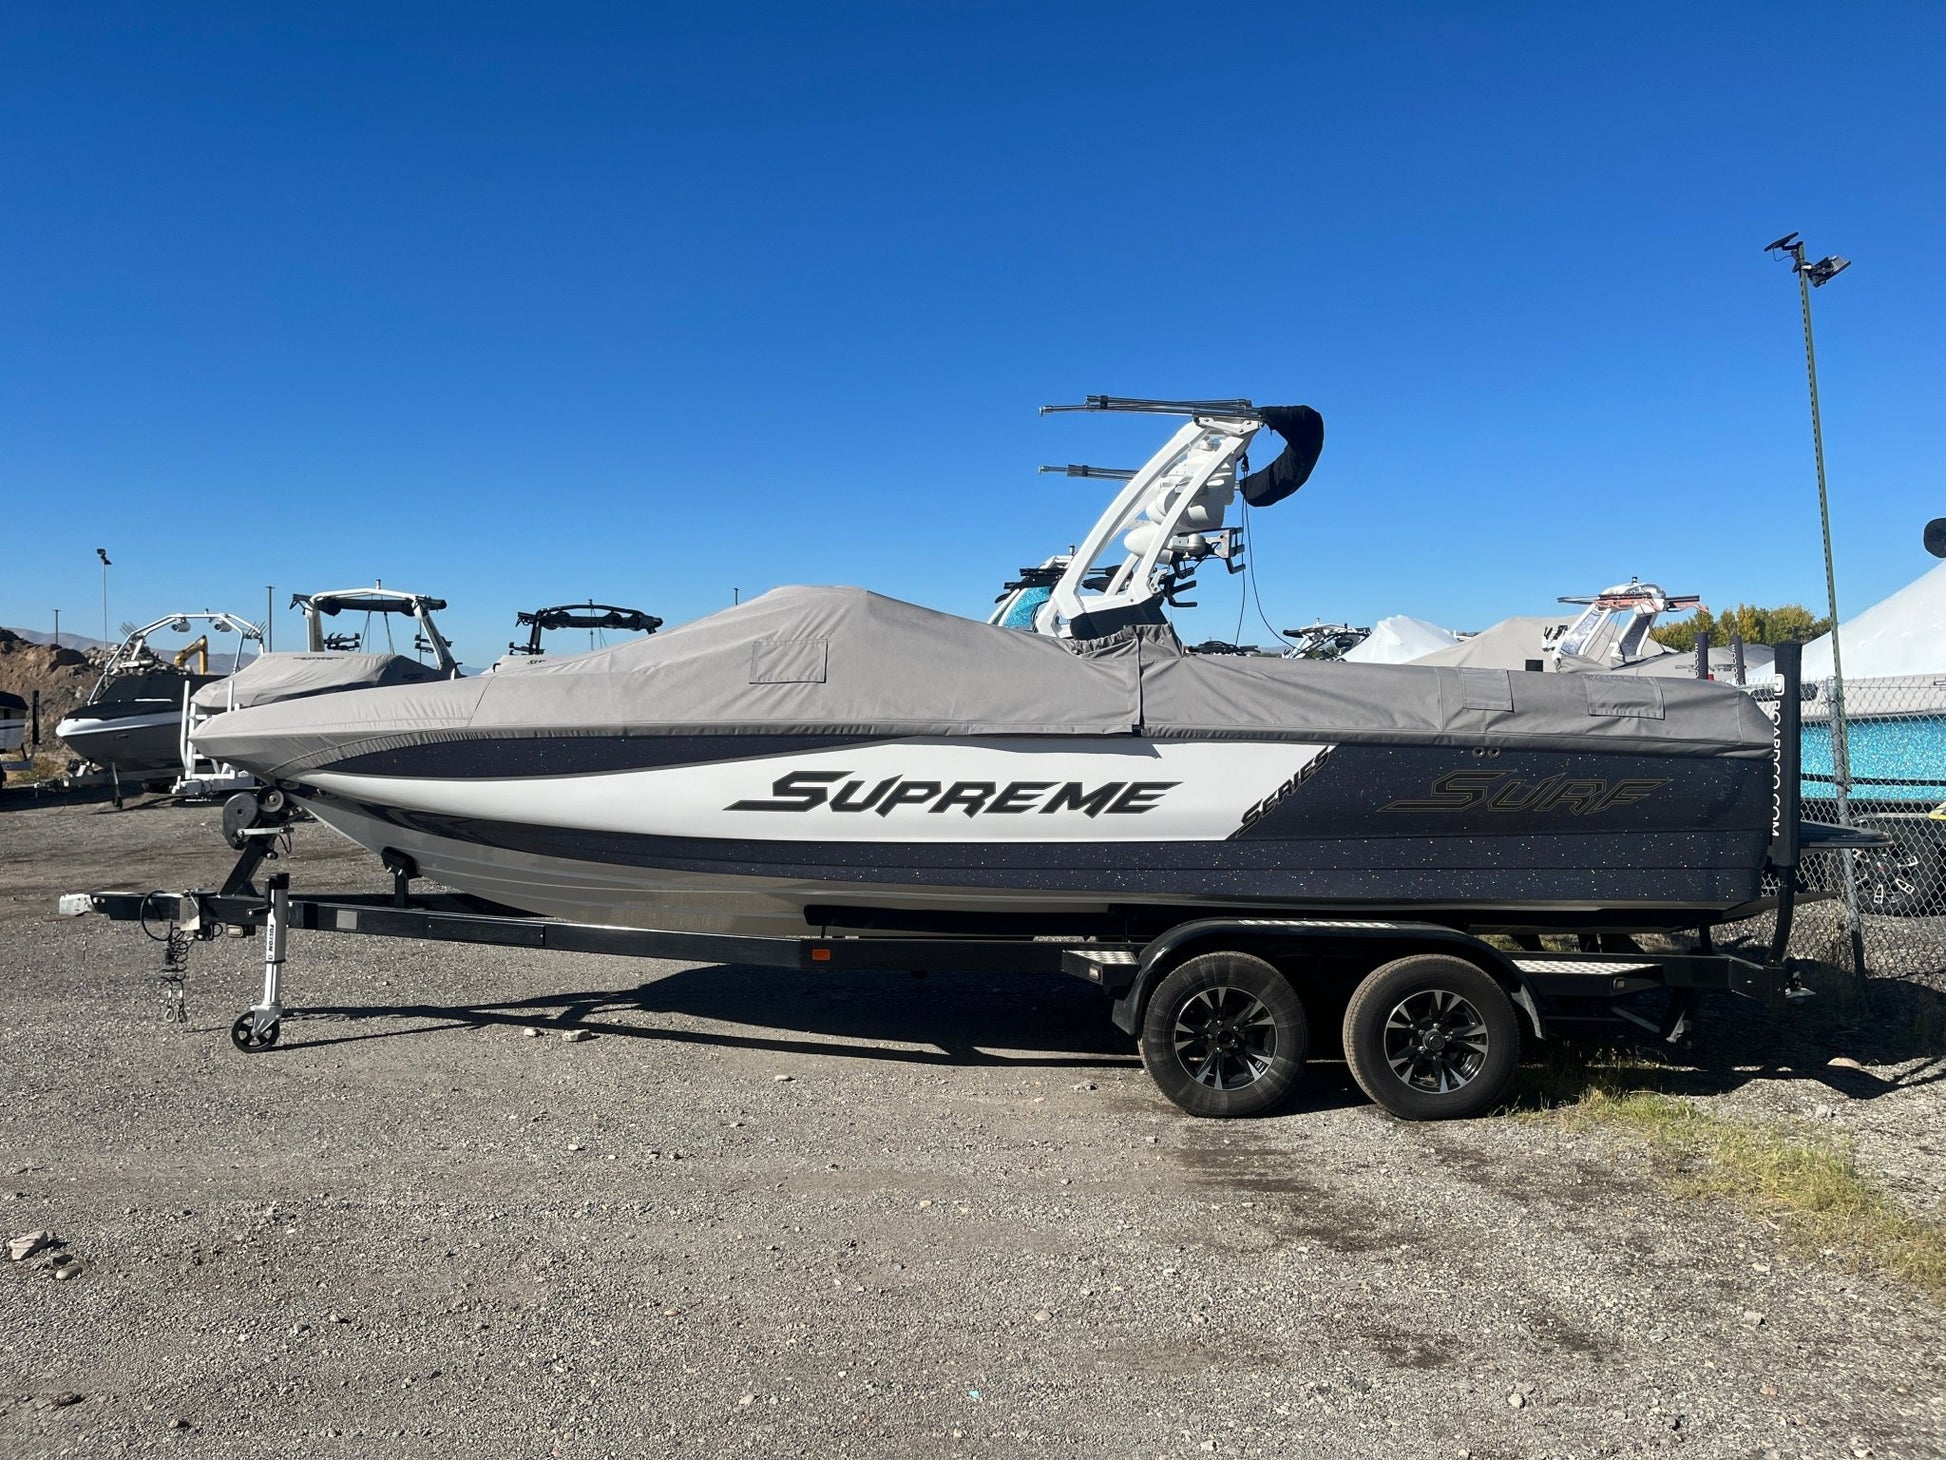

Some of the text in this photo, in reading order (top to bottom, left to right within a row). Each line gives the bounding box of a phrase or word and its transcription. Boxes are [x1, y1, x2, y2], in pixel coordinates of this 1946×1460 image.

[722, 770, 1184, 818] SUPREME
[1236, 745, 1330, 839] SERIES
[1376, 769, 1675, 816] SURF
